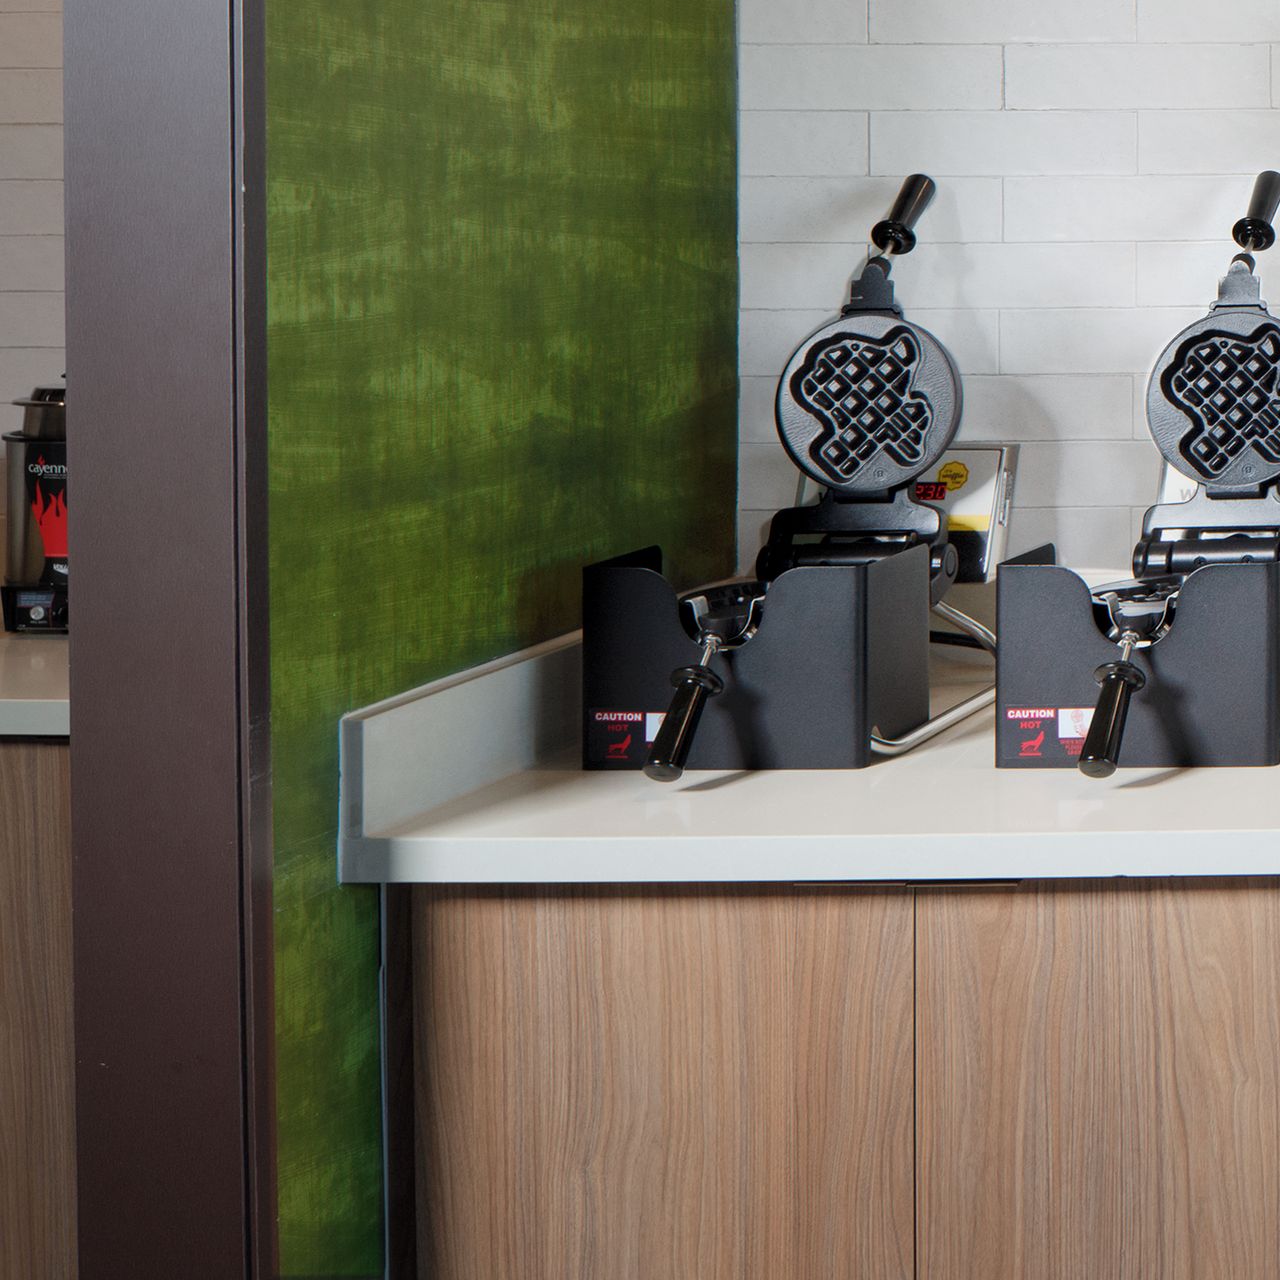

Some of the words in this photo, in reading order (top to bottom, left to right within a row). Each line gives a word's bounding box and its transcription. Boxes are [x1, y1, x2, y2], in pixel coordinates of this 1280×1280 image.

[595, 712, 642, 721] CAUTION
[1007, 710, 1055, 719] CAUTION
[607, 724, 629, 732] HOT
[1020, 721, 1041, 729] HOT
